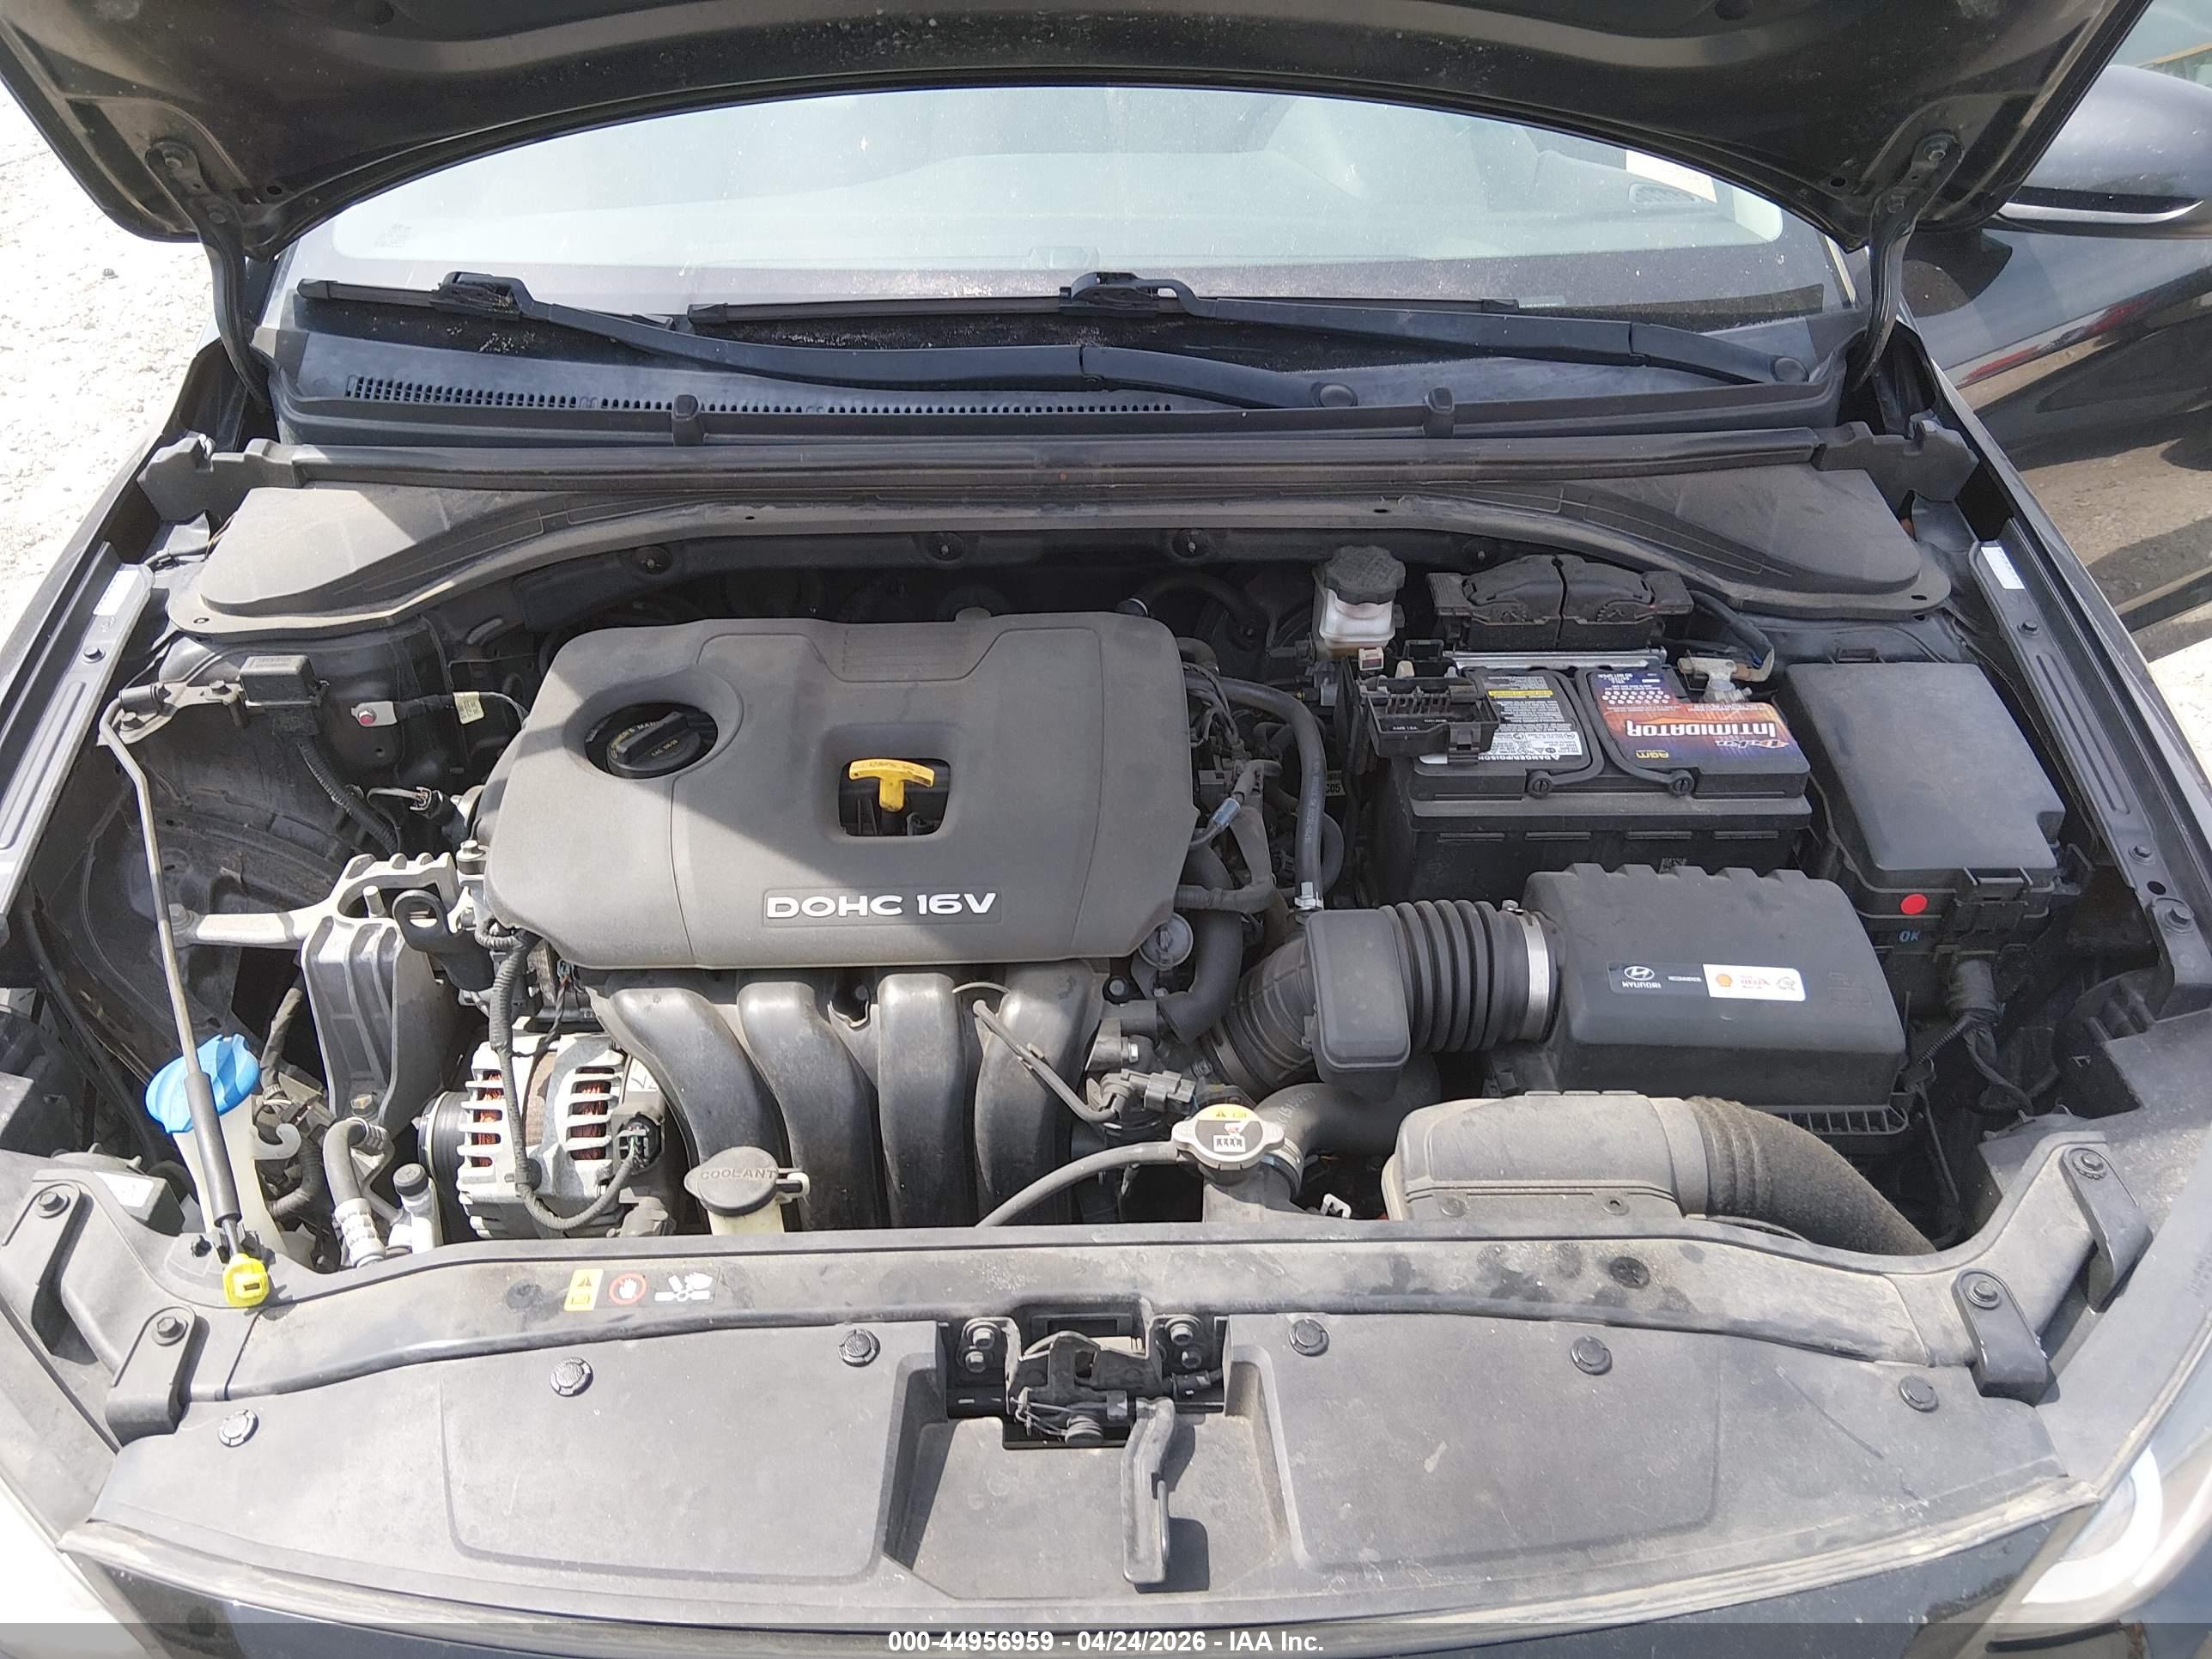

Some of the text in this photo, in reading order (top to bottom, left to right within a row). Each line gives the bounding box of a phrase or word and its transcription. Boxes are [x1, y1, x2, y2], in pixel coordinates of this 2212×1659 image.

[1626, 720, 1777, 738] INTIMIDATOR
[767, 893, 996, 919] DOHC 16V
[1899, 930, 1921, 942] OK
[1621, 981, 1662, 989] HYUNDAI
[701, 1167, 778, 1180] COOLANT
